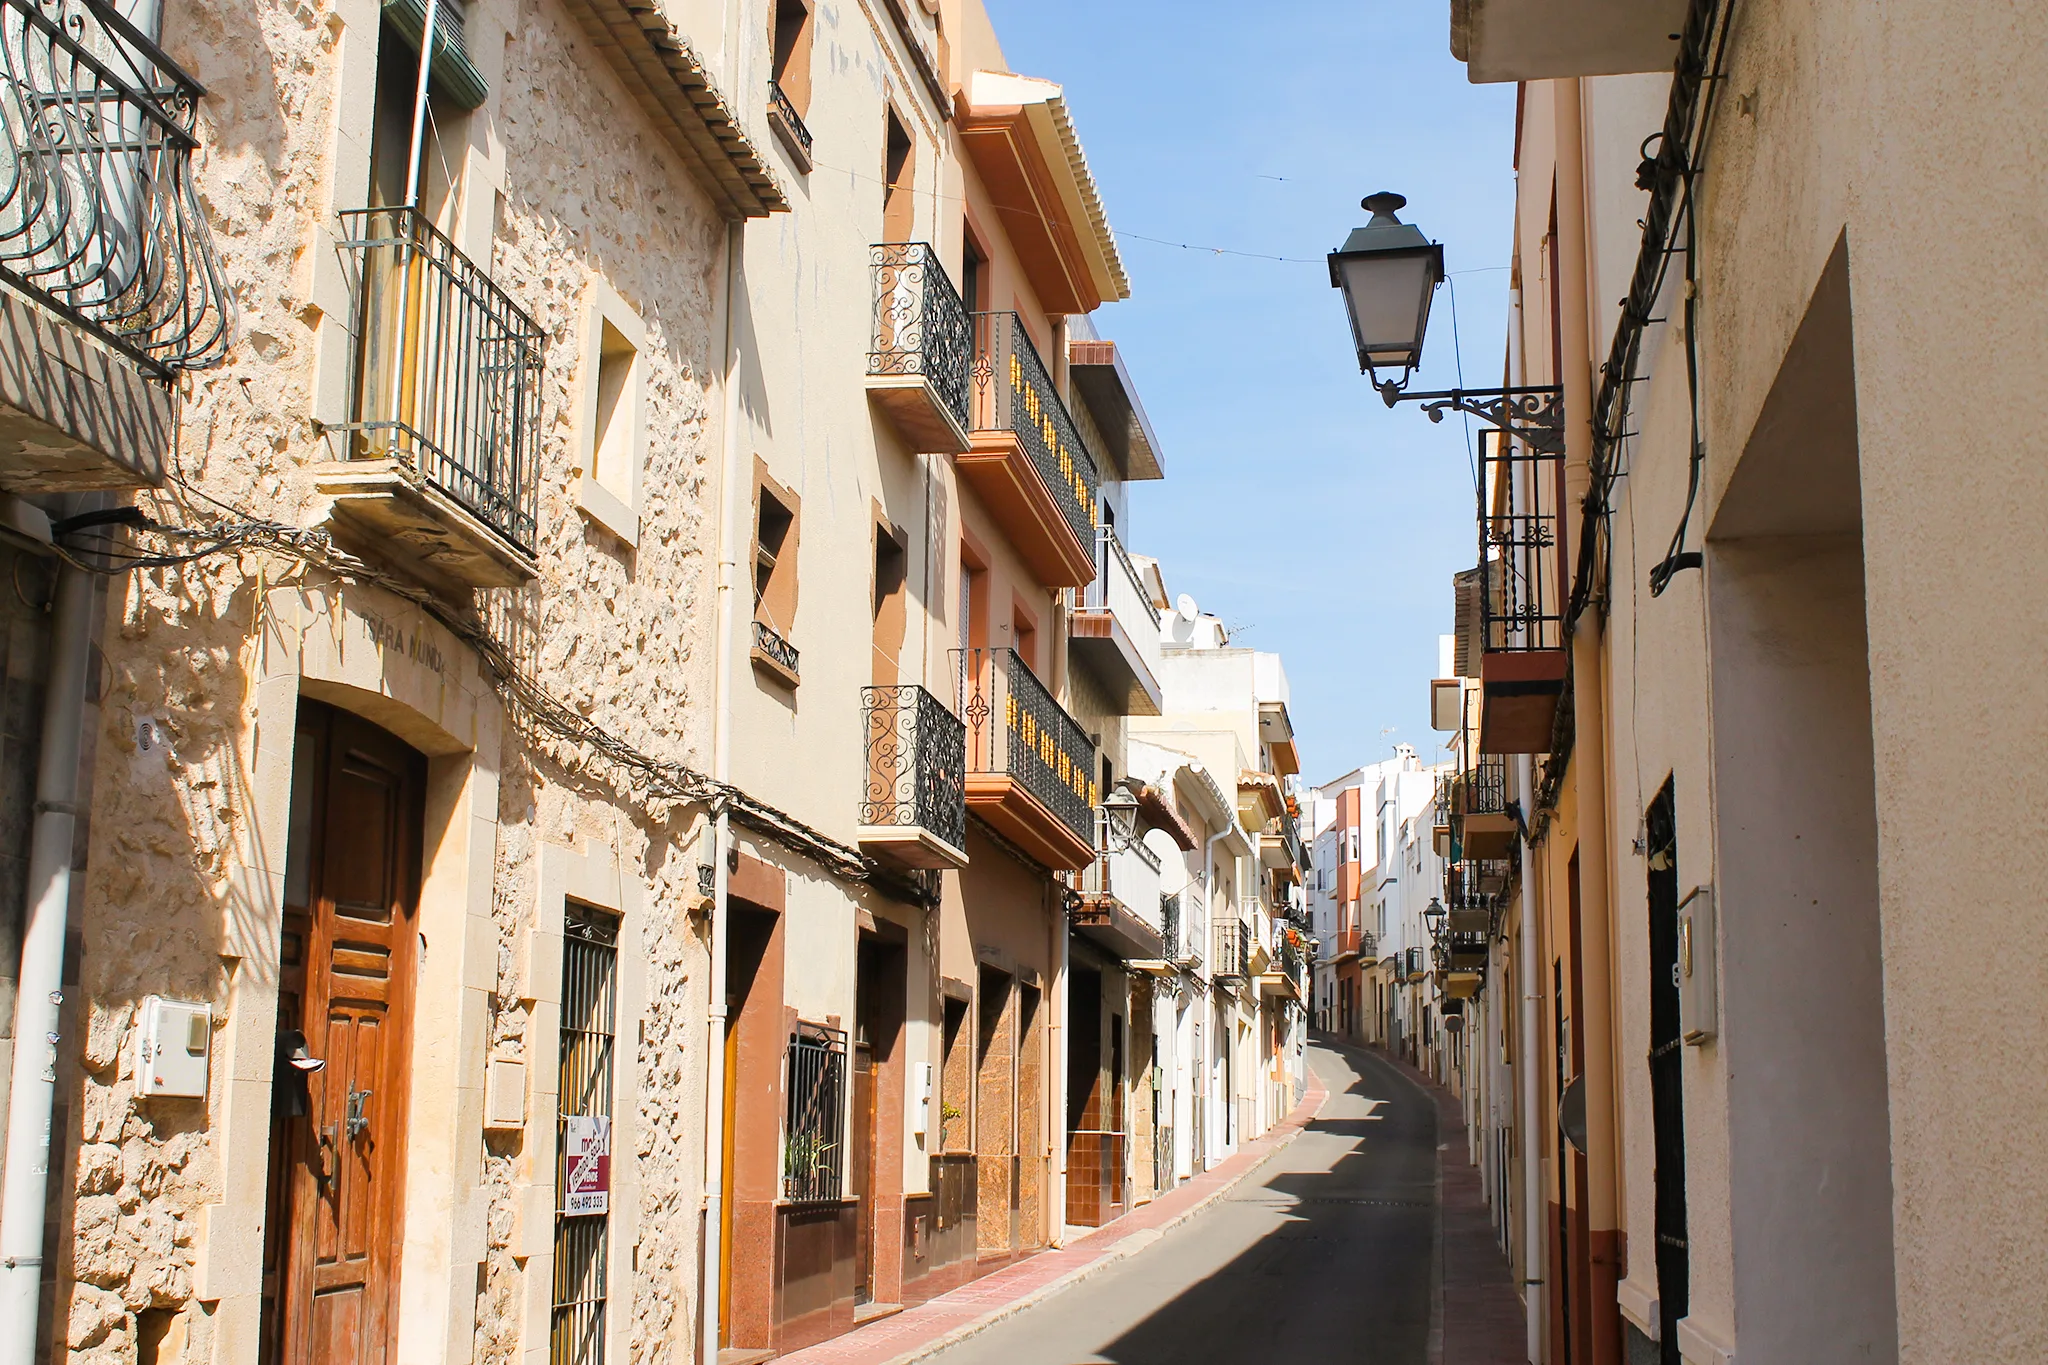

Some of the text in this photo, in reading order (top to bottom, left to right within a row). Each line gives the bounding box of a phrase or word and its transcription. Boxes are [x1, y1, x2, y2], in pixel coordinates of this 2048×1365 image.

[570, 1195, 603, 1209] 966 492 335
